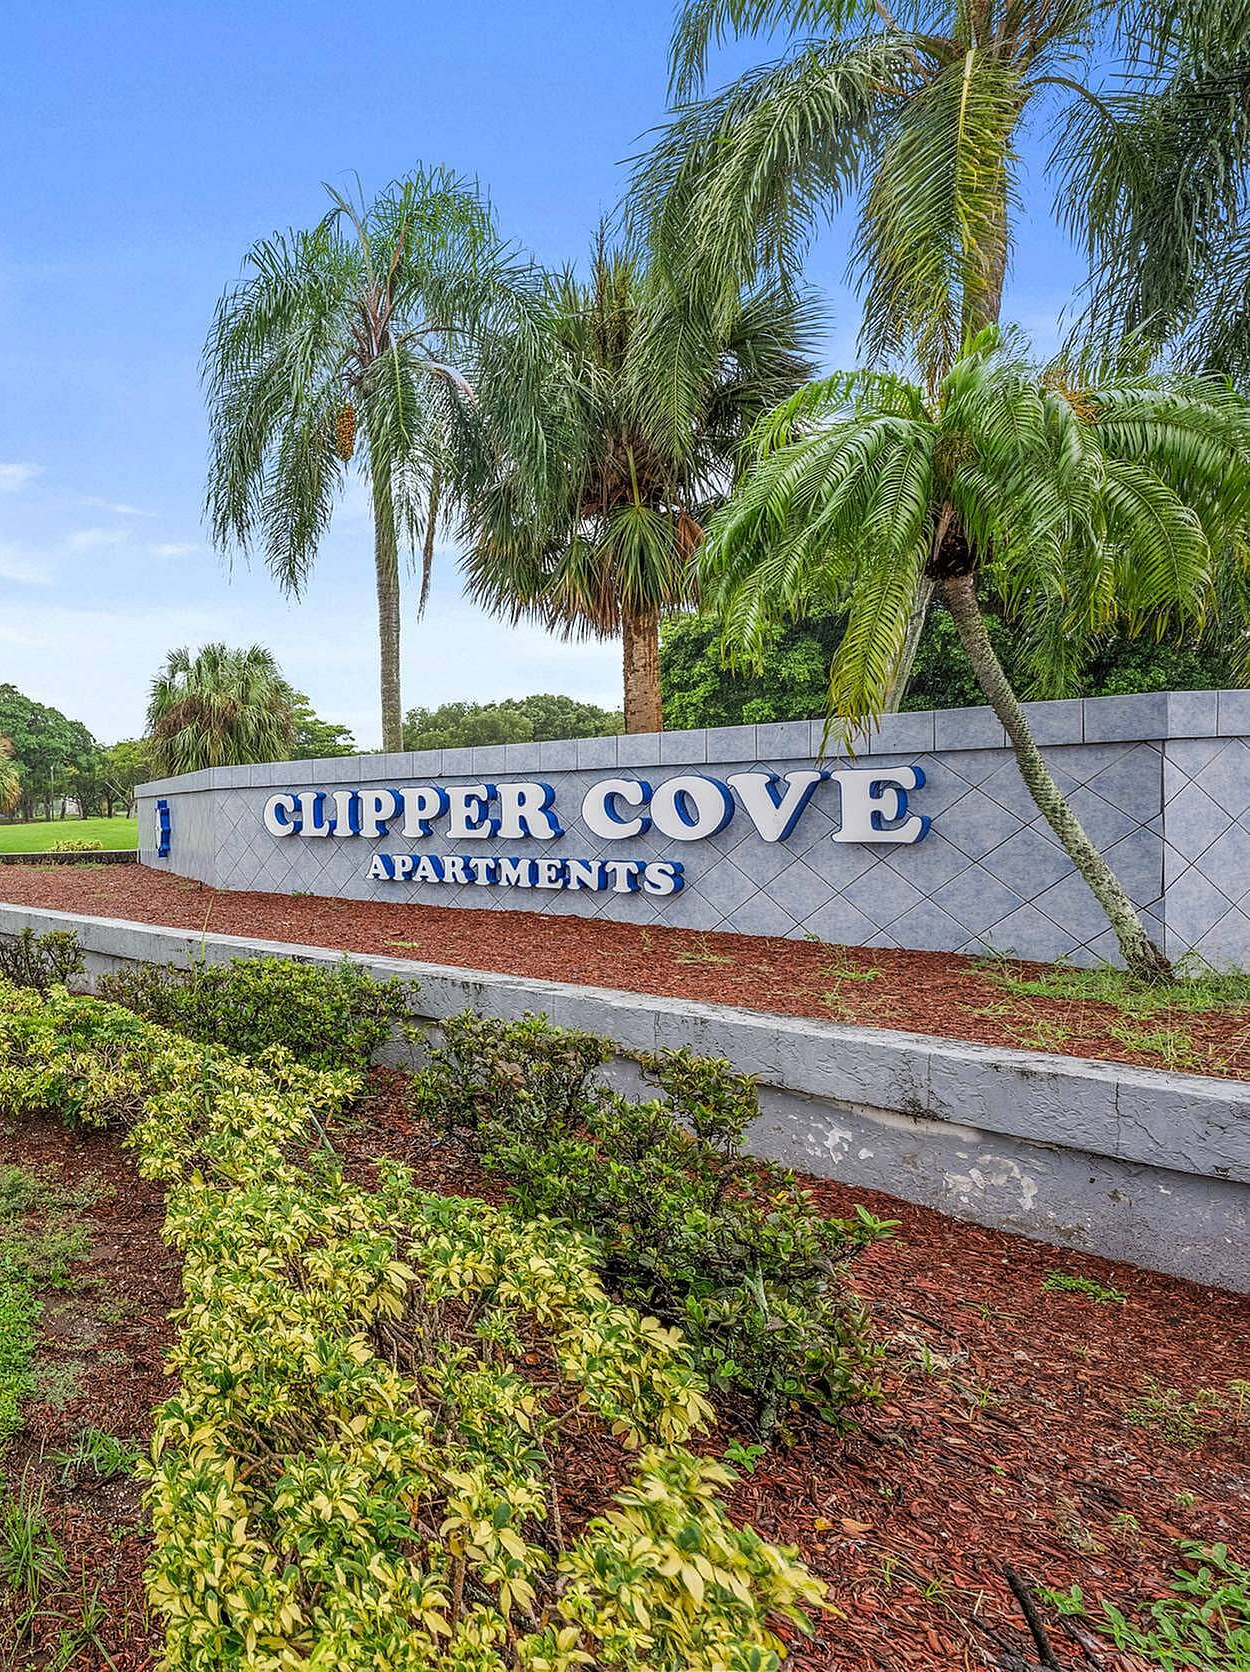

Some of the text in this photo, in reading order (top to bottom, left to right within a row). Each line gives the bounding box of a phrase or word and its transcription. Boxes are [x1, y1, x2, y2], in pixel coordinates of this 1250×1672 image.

[263, 766, 930, 843] CLIPPER COVE
[366, 853, 684, 895] APARTMENTS
